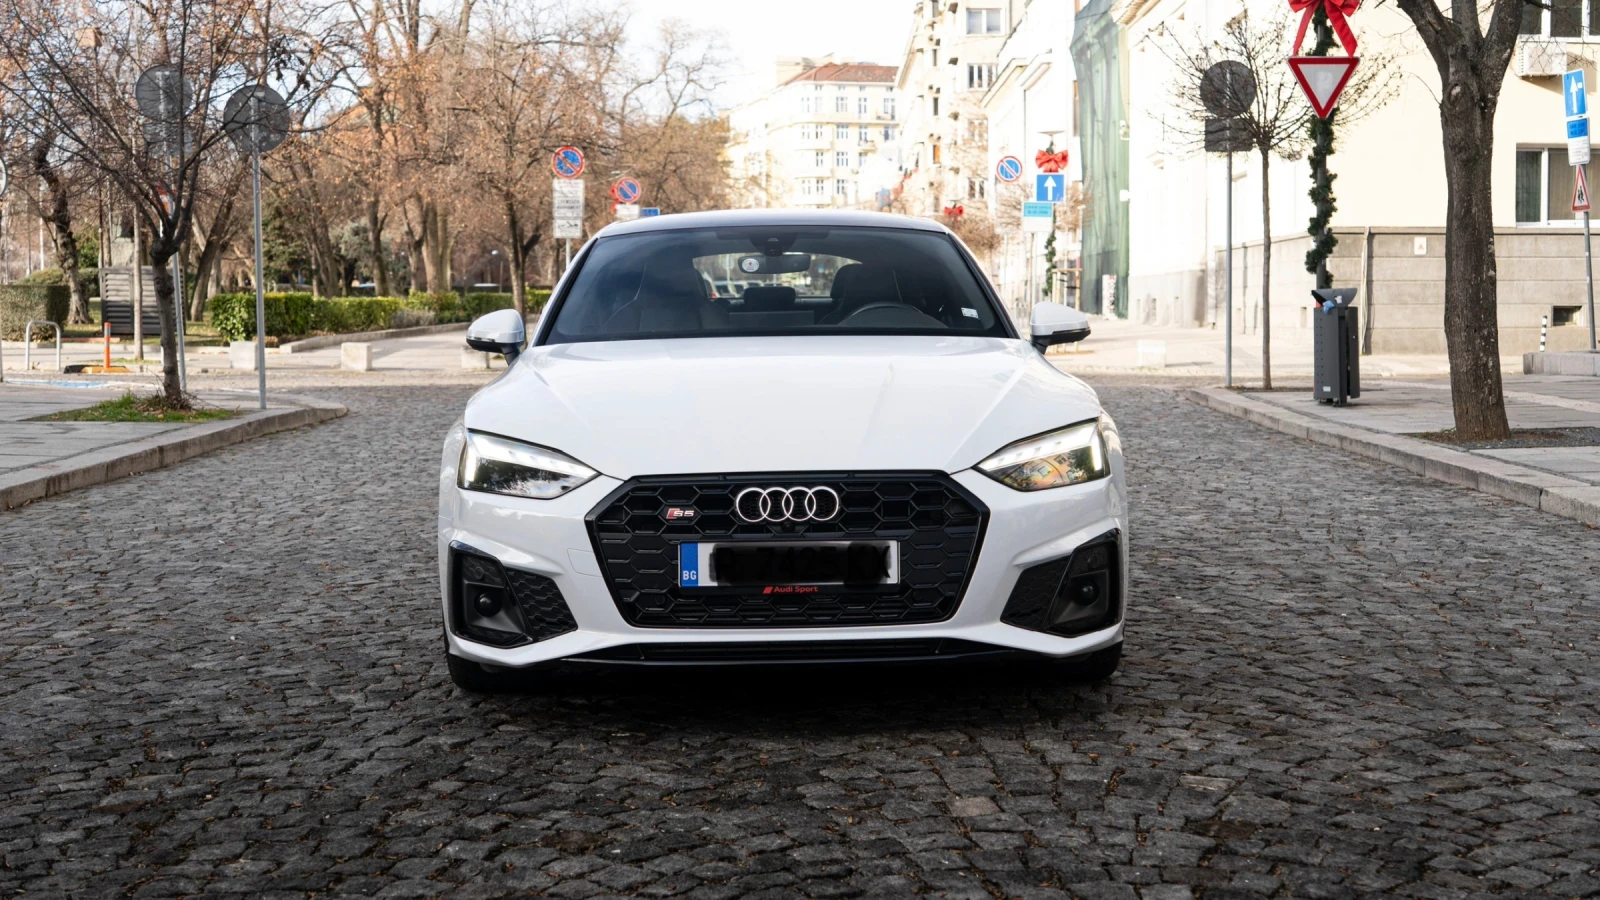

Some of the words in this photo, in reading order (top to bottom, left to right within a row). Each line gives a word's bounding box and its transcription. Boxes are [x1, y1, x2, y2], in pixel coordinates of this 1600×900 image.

[671, 509, 695, 518] S5
[682, 570, 697, 580] BG
[794, 586, 819, 594] Sport
